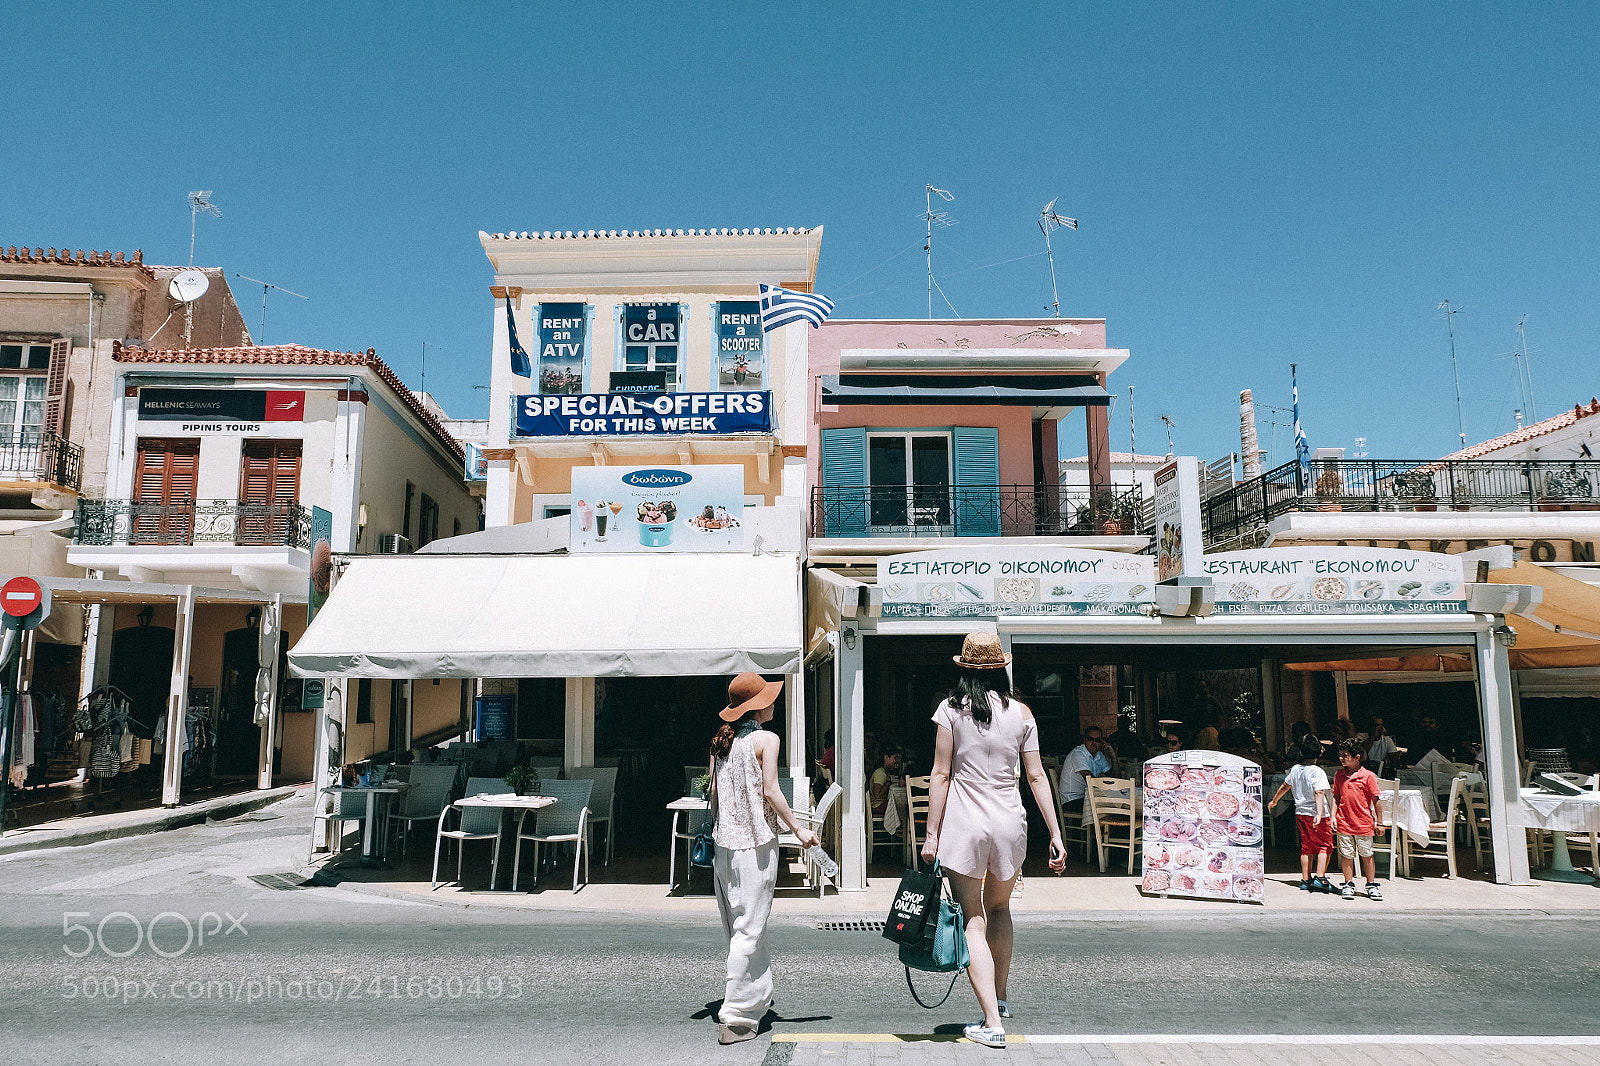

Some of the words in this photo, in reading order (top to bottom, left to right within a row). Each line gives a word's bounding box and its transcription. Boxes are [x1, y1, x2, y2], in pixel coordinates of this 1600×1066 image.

[647, 308, 656, 320] a
[721, 314, 760, 324] RENT
[542, 318, 582, 328] RENT
[552, 331, 571, 340] an
[628, 323, 676, 341] CAR
[736, 327, 746, 336] a
[542, 344, 580, 356] ATV
[721, 338, 760, 351] SCOOTER
[524, 396, 643, 416] SPECIAL
[654, 394, 764, 414] OFFERS
[182, 424, 222, 432] PIPINIS
[226, 424, 260, 432] TOURS
[569, 418, 608, 432] FOR
[609, 418, 656, 432] THIS
[661, 416, 716, 431] WEEK
[888, 561, 991, 575] ΕΣΤΙΑΤΟΡΙΟ
[1228, 604, 1247, 612] FISH
[1260, 604, 1283, 612] PIZZA
[1296, 604, 1330, 612] GRILLED
[1345, 604, 1396, 612] MOUSSAKA
[1408, 602, 1460, 612] SPAGHETTI
[900, 890, 924, 904] SHOP
[894, 899, 924, 916] ONLINE
